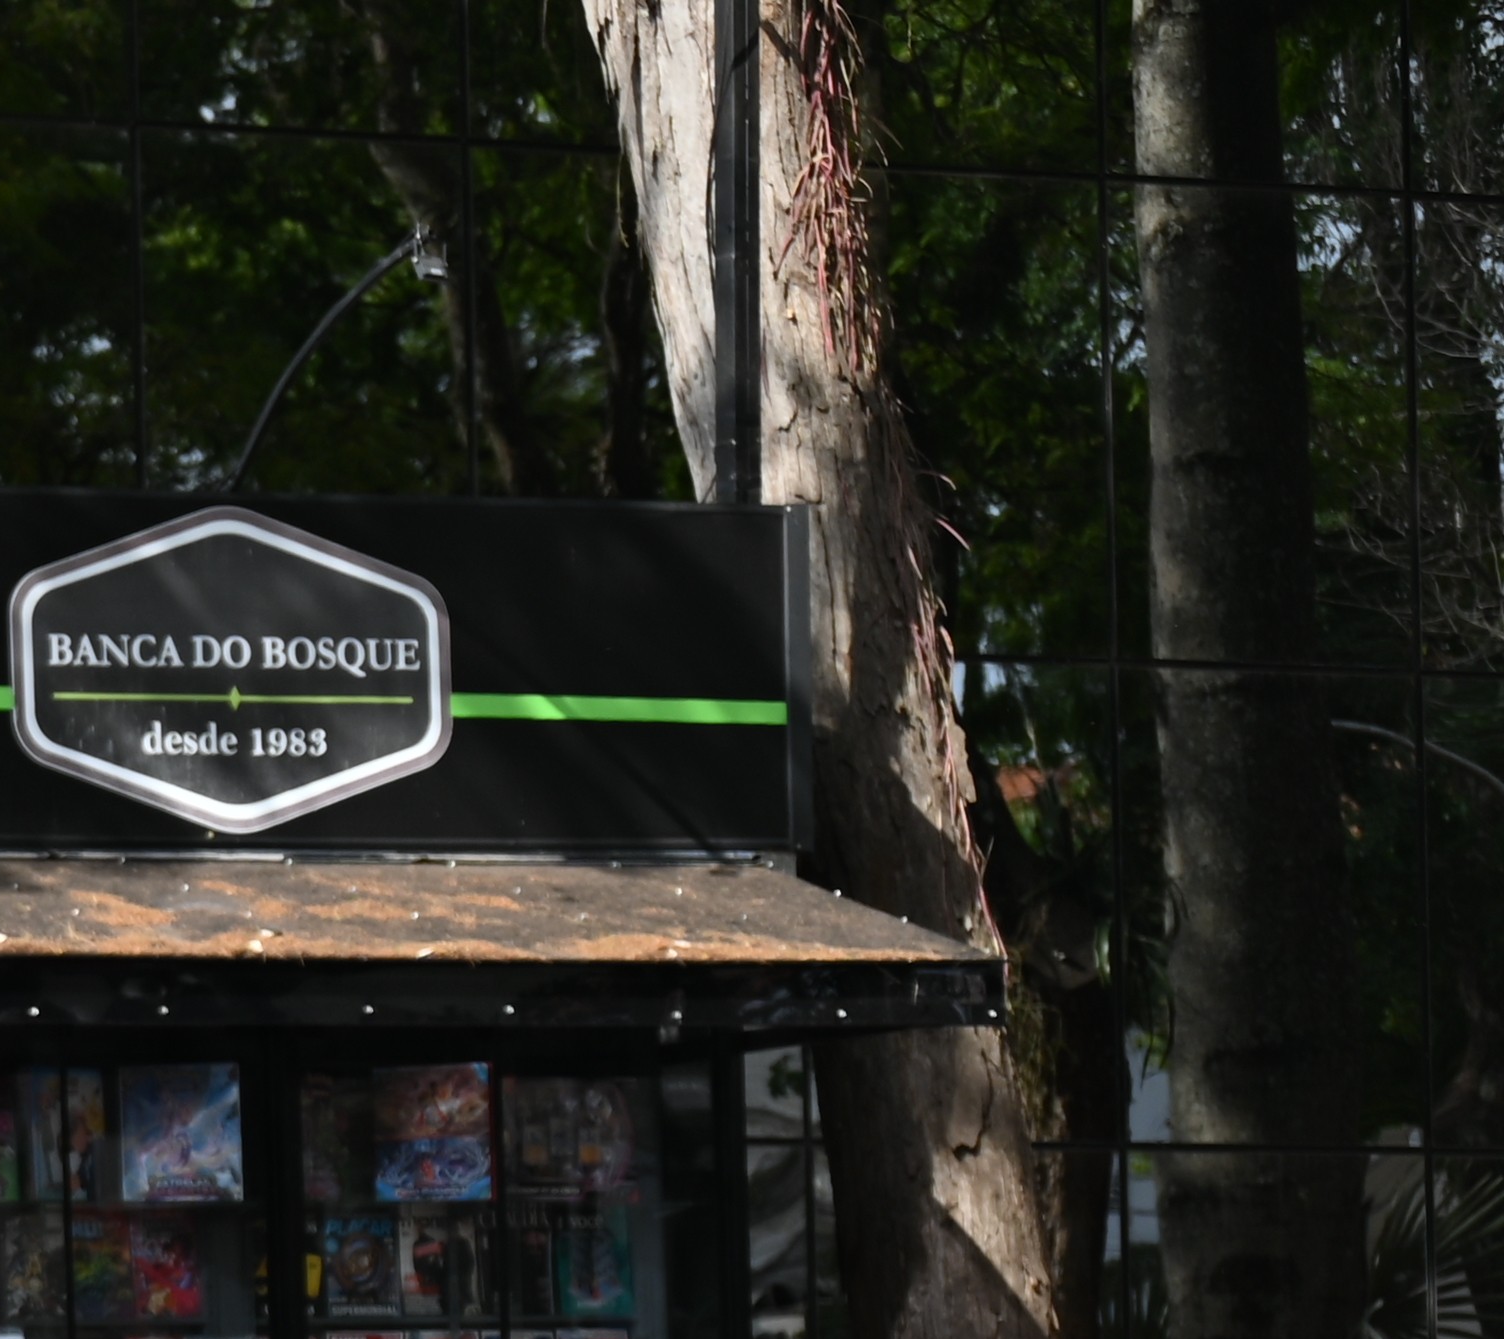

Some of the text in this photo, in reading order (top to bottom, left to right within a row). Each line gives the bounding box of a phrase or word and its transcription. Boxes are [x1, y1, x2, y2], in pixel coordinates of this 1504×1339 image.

[48, 633, 421, 678] BANCA DO BOSQUE
[142, 721, 238, 757] desde
